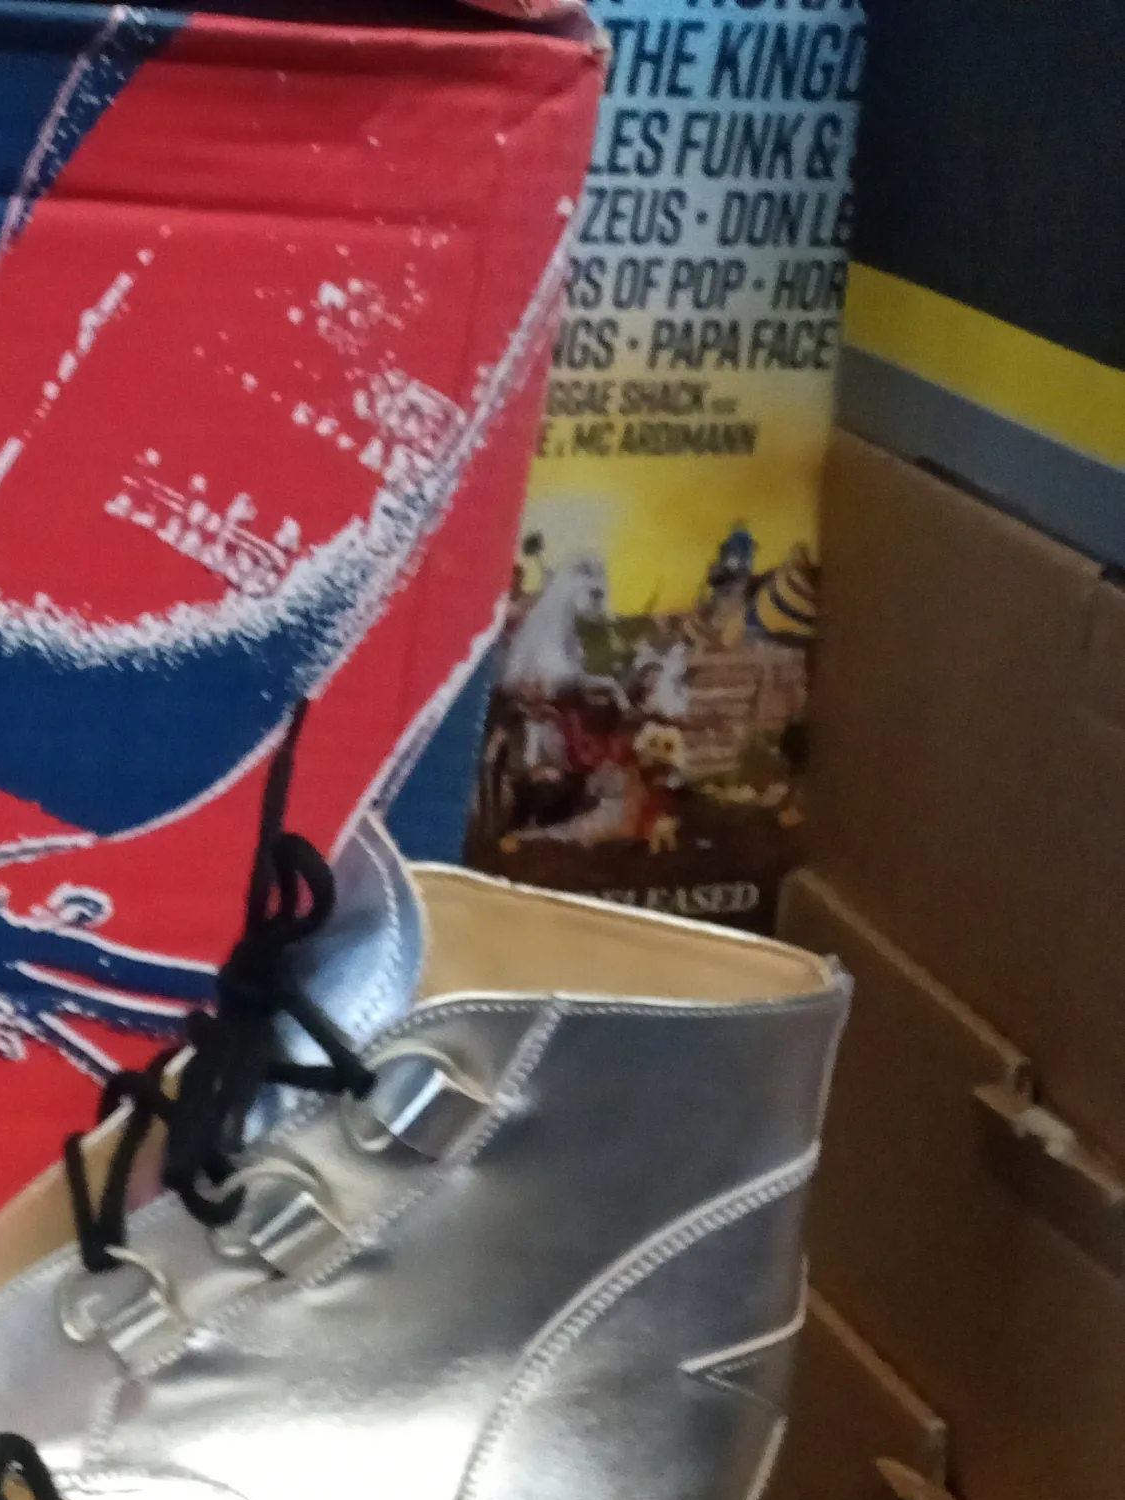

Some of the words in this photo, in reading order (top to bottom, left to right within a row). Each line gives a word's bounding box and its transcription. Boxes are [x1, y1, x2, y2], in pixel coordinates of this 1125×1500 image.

[604, 18, 706, 98] THE
[675, 110, 805, 181] FUNK
[579, 186, 688, 246] ZEUS
[717, 188, 808, 249] DON
[611, 256, 664, 312] OF
[667, 257, 749, 312] POP
[647, 317, 742, 371] PAPA
